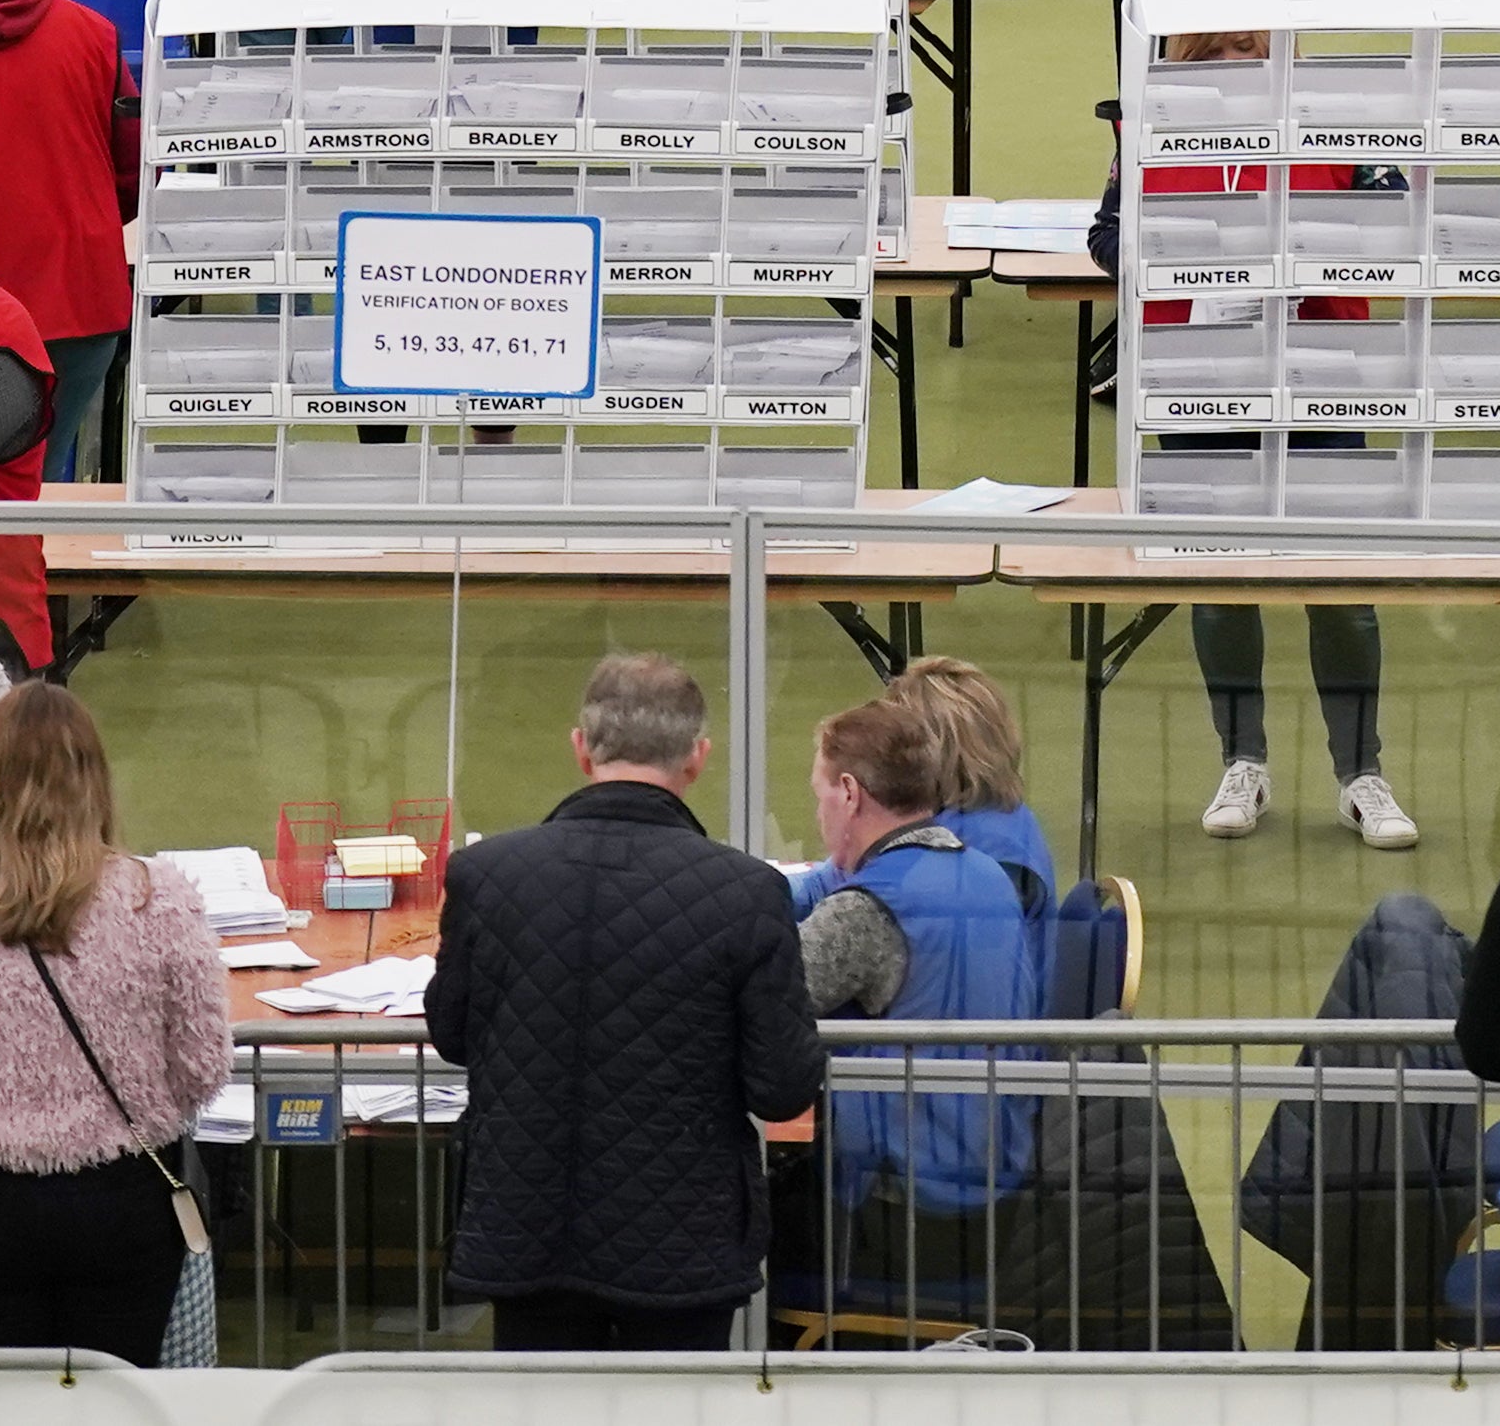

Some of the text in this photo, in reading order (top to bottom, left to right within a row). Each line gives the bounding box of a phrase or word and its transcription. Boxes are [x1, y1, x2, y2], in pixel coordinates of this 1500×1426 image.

[168, 131, 847, 153] ARCHIBALD ARMSTRONG BRADLEY BROLLY COULSON
[1161, 137, 1270, 151] ARCHIBALD
[1302, 134, 1422, 147] ARMSTRONG
[171, 262, 833, 281] HUNTER MERRON MURPHY
[361, 265, 586, 285] EAST LONDONDERRY
[1174, 271, 1249, 284] HUNTER
[1323, 269, 1394, 281] MCCAW
[362, 295, 568, 312] VERIFICATION OF BOXES
[374, 335, 567, 356] 5, 19, 33, 47, 61, 71
[169, 397, 826, 417] QUIGLEY ROBINSON SUGDEN WATTON
[1169, 403, 1251, 415] QUIGLEY
[1305, 397, 1406, 416] ROBINSON
